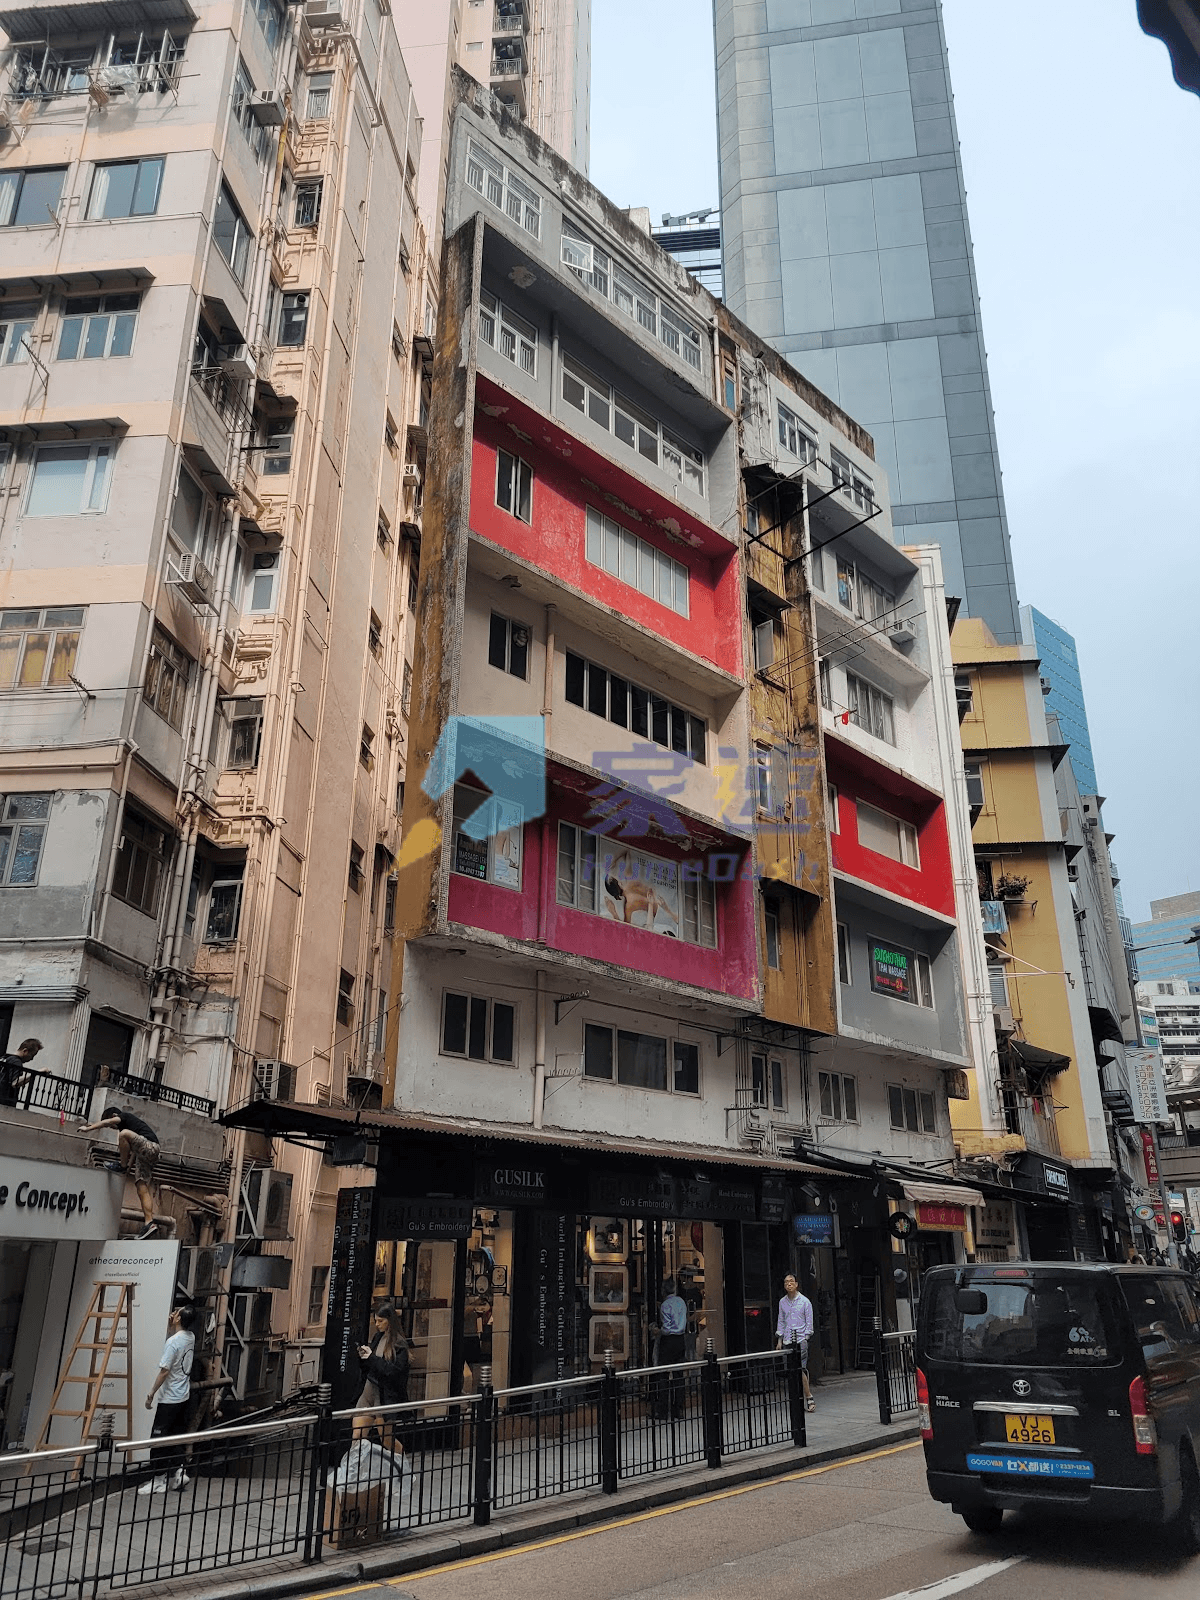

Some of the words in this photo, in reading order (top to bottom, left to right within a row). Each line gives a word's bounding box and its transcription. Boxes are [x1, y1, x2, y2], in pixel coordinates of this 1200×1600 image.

[1138, 1065, 1148, 1091] HONG
[1143, 1093, 1153, 1119] KONG
[1146, 1145, 1158, 1174] 成人用品
[494, 1168, 545, 1188] GUSILK
[16, 1181, 89, 1219] Concept.
[352, 1192, 361, 1219] World
[619, 1197, 636, 1207] Gu's
[638, 1198, 675, 1209] Embroidery
[408, 1221, 426, 1231] Gu's
[429, 1222, 471, 1233] Embroidery
[558, 1215, 566, 1243] World
[89, 1256, 164, 1267] @thecareconcept
[347, 1222, 359, 1274] Intangible
[327, 1259, 338, 1316] Embroidery
[557, 1247, 566, 1301] Intangible
[343, 1278, 354, 1322] Cultural
[538, 1286, 547, 1347] Embroidery
[557, 1306, 565, 1352] Cultural
[339, 1326, 350, 1372] Heritage
[936, 1400, 961, 1408] HIACE
[1108, 1409, 1121, 1417] GL
[1010, 1429, 1051, 1443] 4926
[1019, 1416, 1039, 1429] VJ
